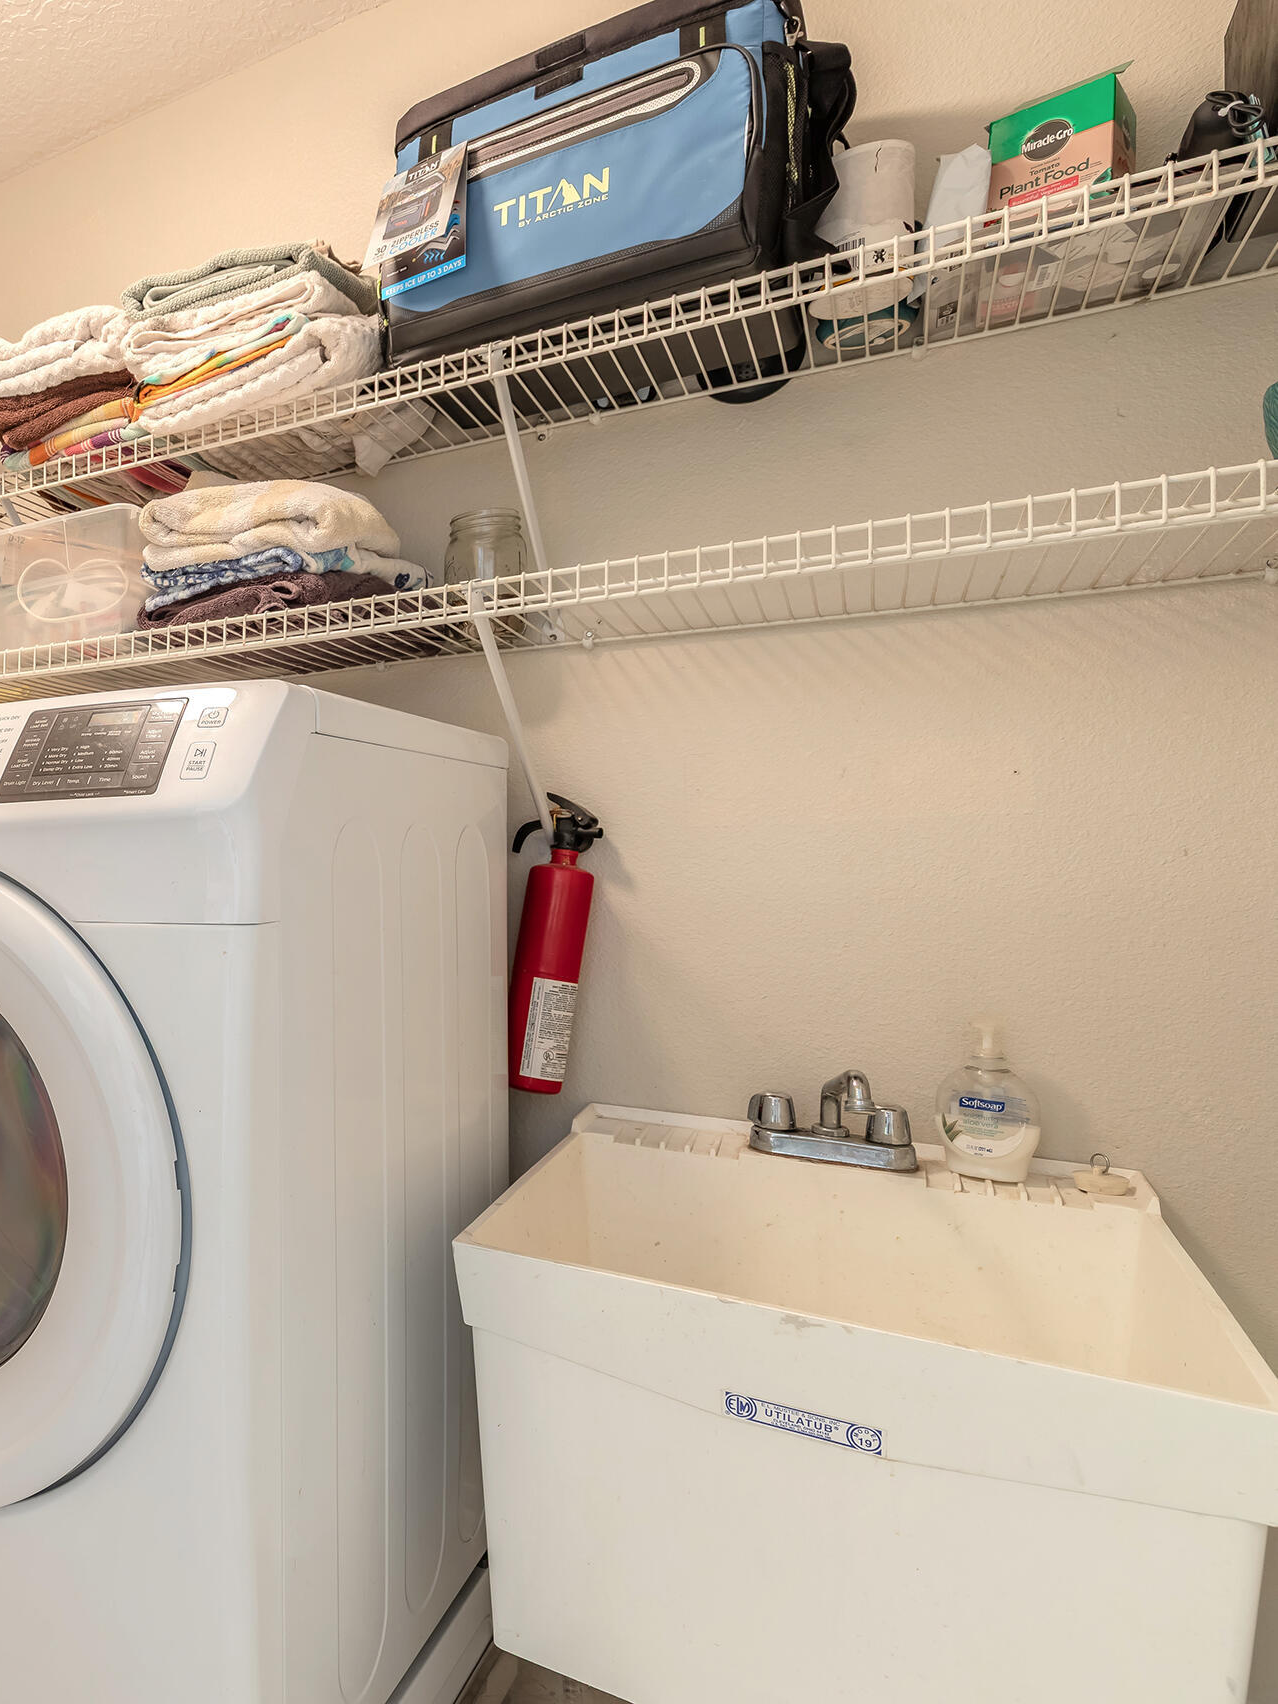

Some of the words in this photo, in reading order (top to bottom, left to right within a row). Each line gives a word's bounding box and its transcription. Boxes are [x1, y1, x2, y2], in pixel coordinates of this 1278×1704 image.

[1022, 127, 1073, 154] Miracle-Gro
[408, 159, 440, 181] TITAN
[1000, 176, 1042, 200] Plant
[1044, 157, 1090, 183] Food
[1029, 162, 1060, 176] Tomato
[493, 167, 610, 226] TITAN
[518, 218, 532, 228] BY
[534, 204, 574, 223] ARCTIC
[577, 193, 609, 209] ZONE
[389, 227, 438, 255] COOLER
[391, 220, 440, 247] ZIPPERLESS
[385, 283, 404, 296] KEEPS
[404, 278, 416, 288] ICE
[417, 274, 427, 283] UP
[427, 271, 436, 279] TO
[961, 1098, 1003, 1111] Softsoap
[853, 1429, 878, 1442] MODEL
[858, 1437, 872, 1448] 19
